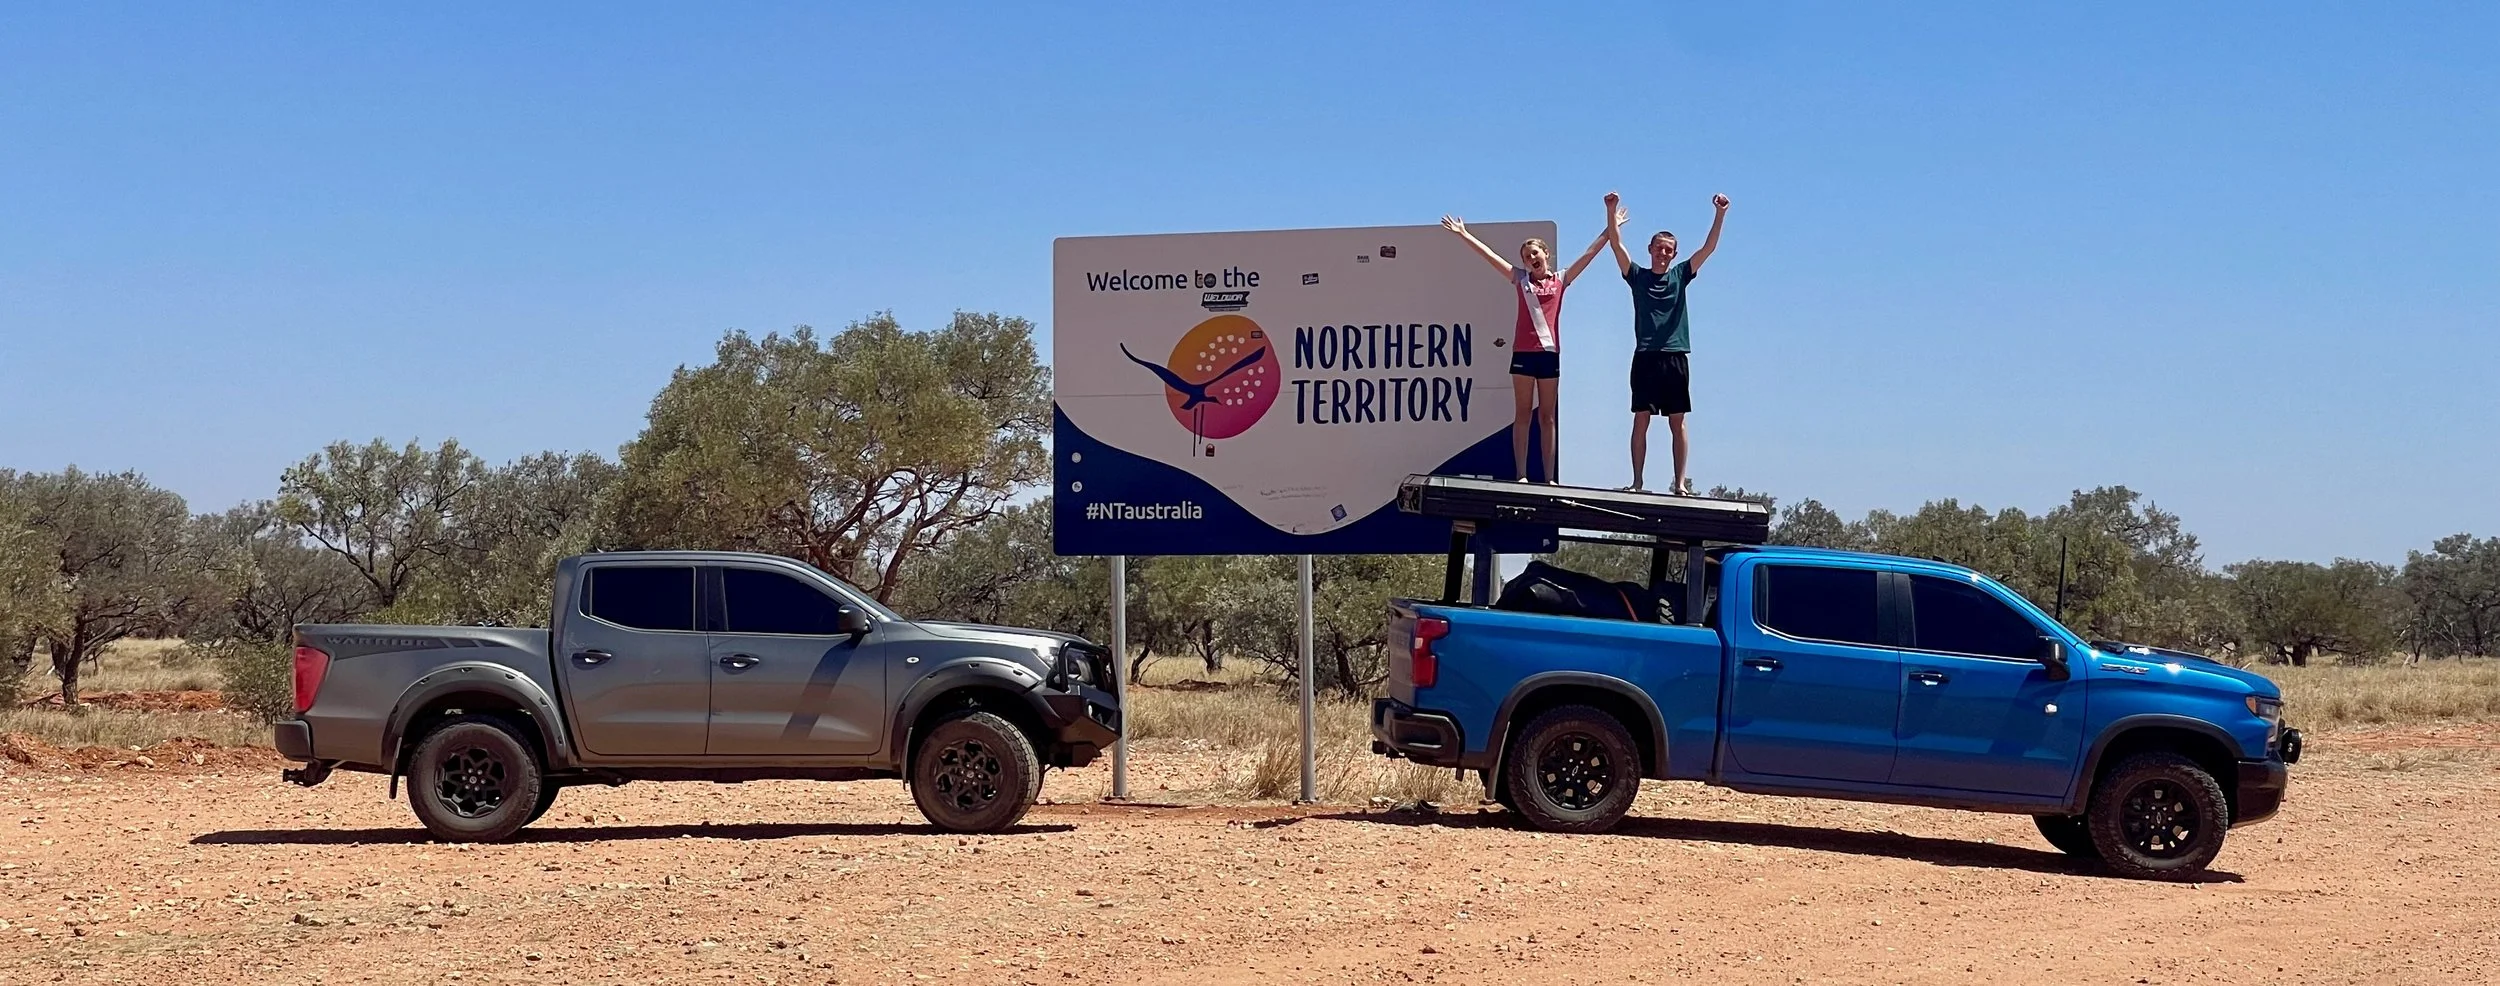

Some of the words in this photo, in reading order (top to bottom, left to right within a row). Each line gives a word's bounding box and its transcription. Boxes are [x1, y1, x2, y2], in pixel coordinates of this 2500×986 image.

[1087, 269, 1188, 291] Welcome
[1195, 270, 1217, 289] to
[1223, 266, 1260, 288] the
[1295, 323, 1472, 371] NORTHERN
[1291, 377, 1472, 424] TERRITORY
[1086, 501, 1203, 520] #NTaustralia
[326, 636, 429, 647] WARRIOR
